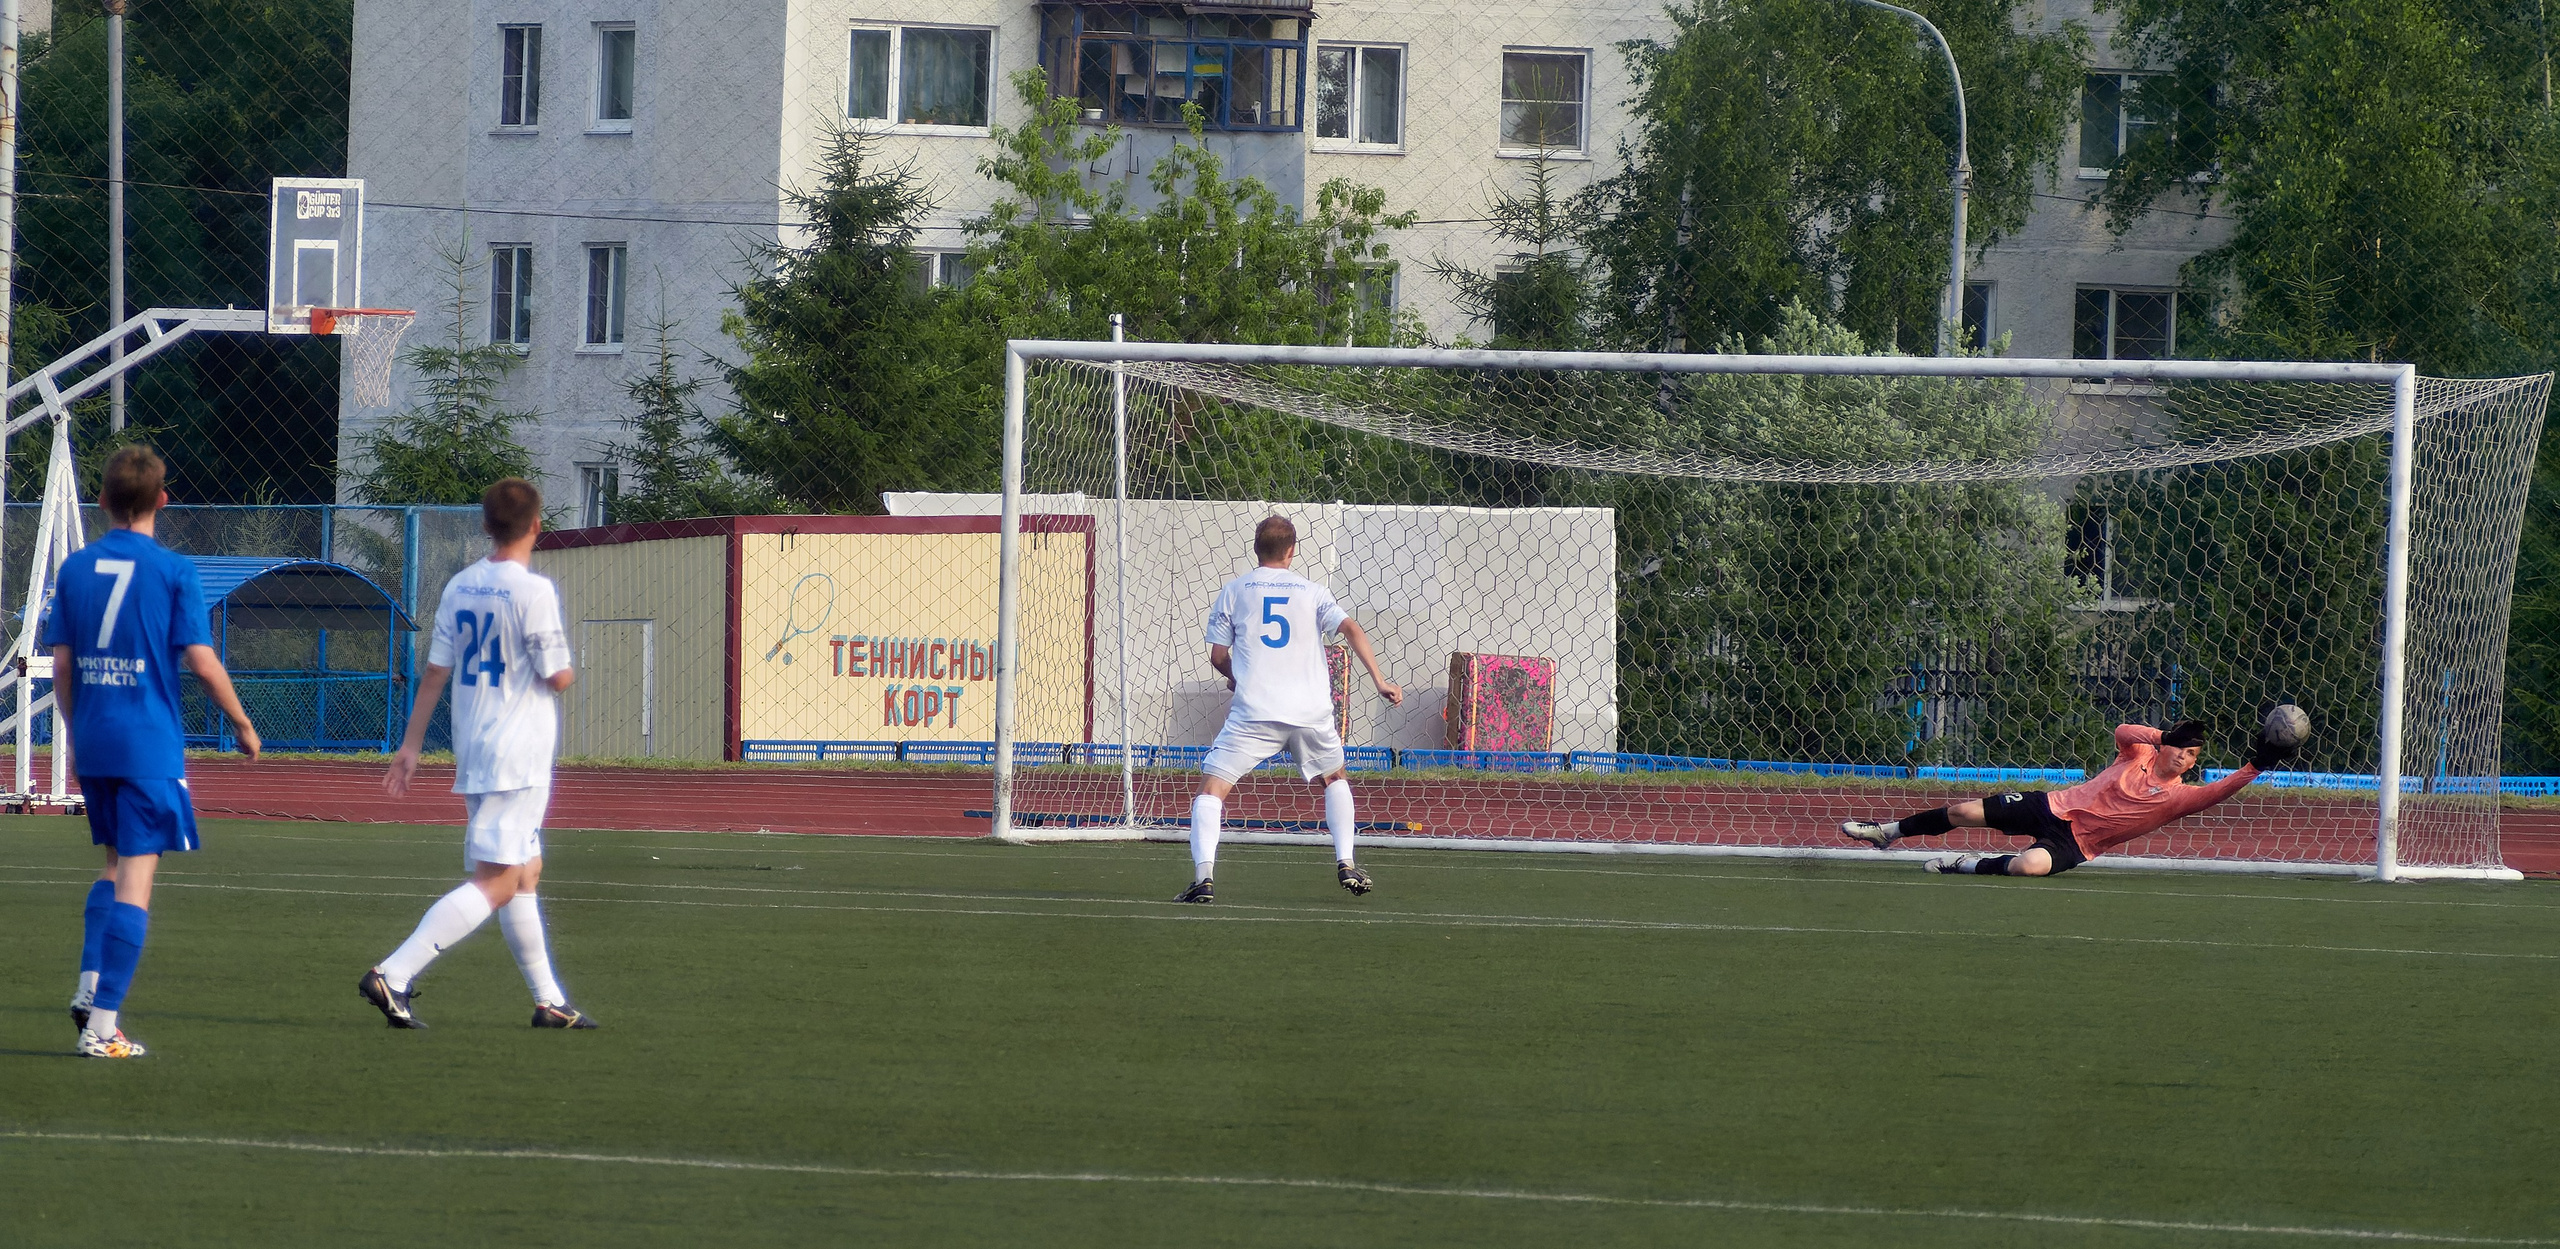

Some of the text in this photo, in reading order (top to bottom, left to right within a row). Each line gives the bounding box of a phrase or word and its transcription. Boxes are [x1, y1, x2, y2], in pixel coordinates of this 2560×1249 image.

[310, 190, 341, 206] GÜNTER
[310, 205, 325, 218] CUP
[94, 558, 136, 649] 7
[1259, 596, 1291, 649] 5
[455, 609, 506, 688] 24
[829, 635, 999, 682] ТЕННИСНЫ
[883, 685, 963, 729] КОРТ
